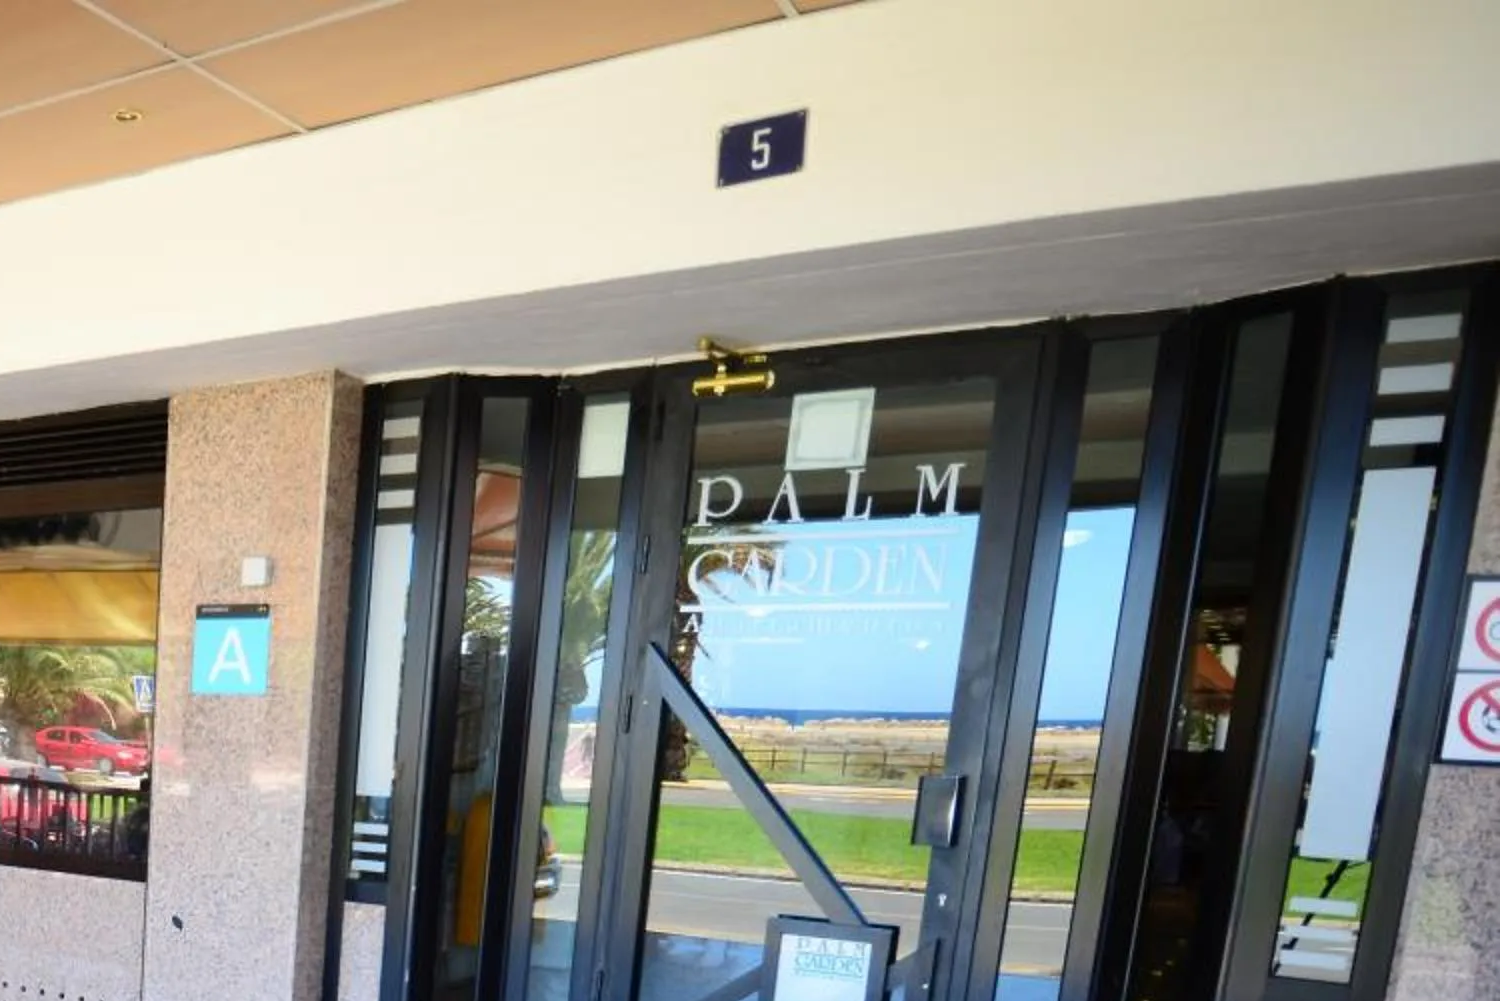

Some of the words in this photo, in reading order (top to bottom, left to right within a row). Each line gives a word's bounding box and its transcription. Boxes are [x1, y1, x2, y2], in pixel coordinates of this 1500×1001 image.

[751, 126, 773, 171] 5
[692, 462, 966, 527] PALM
[686, 543, 948, 603] GARDEN
[207, 625, 252, 686] A
